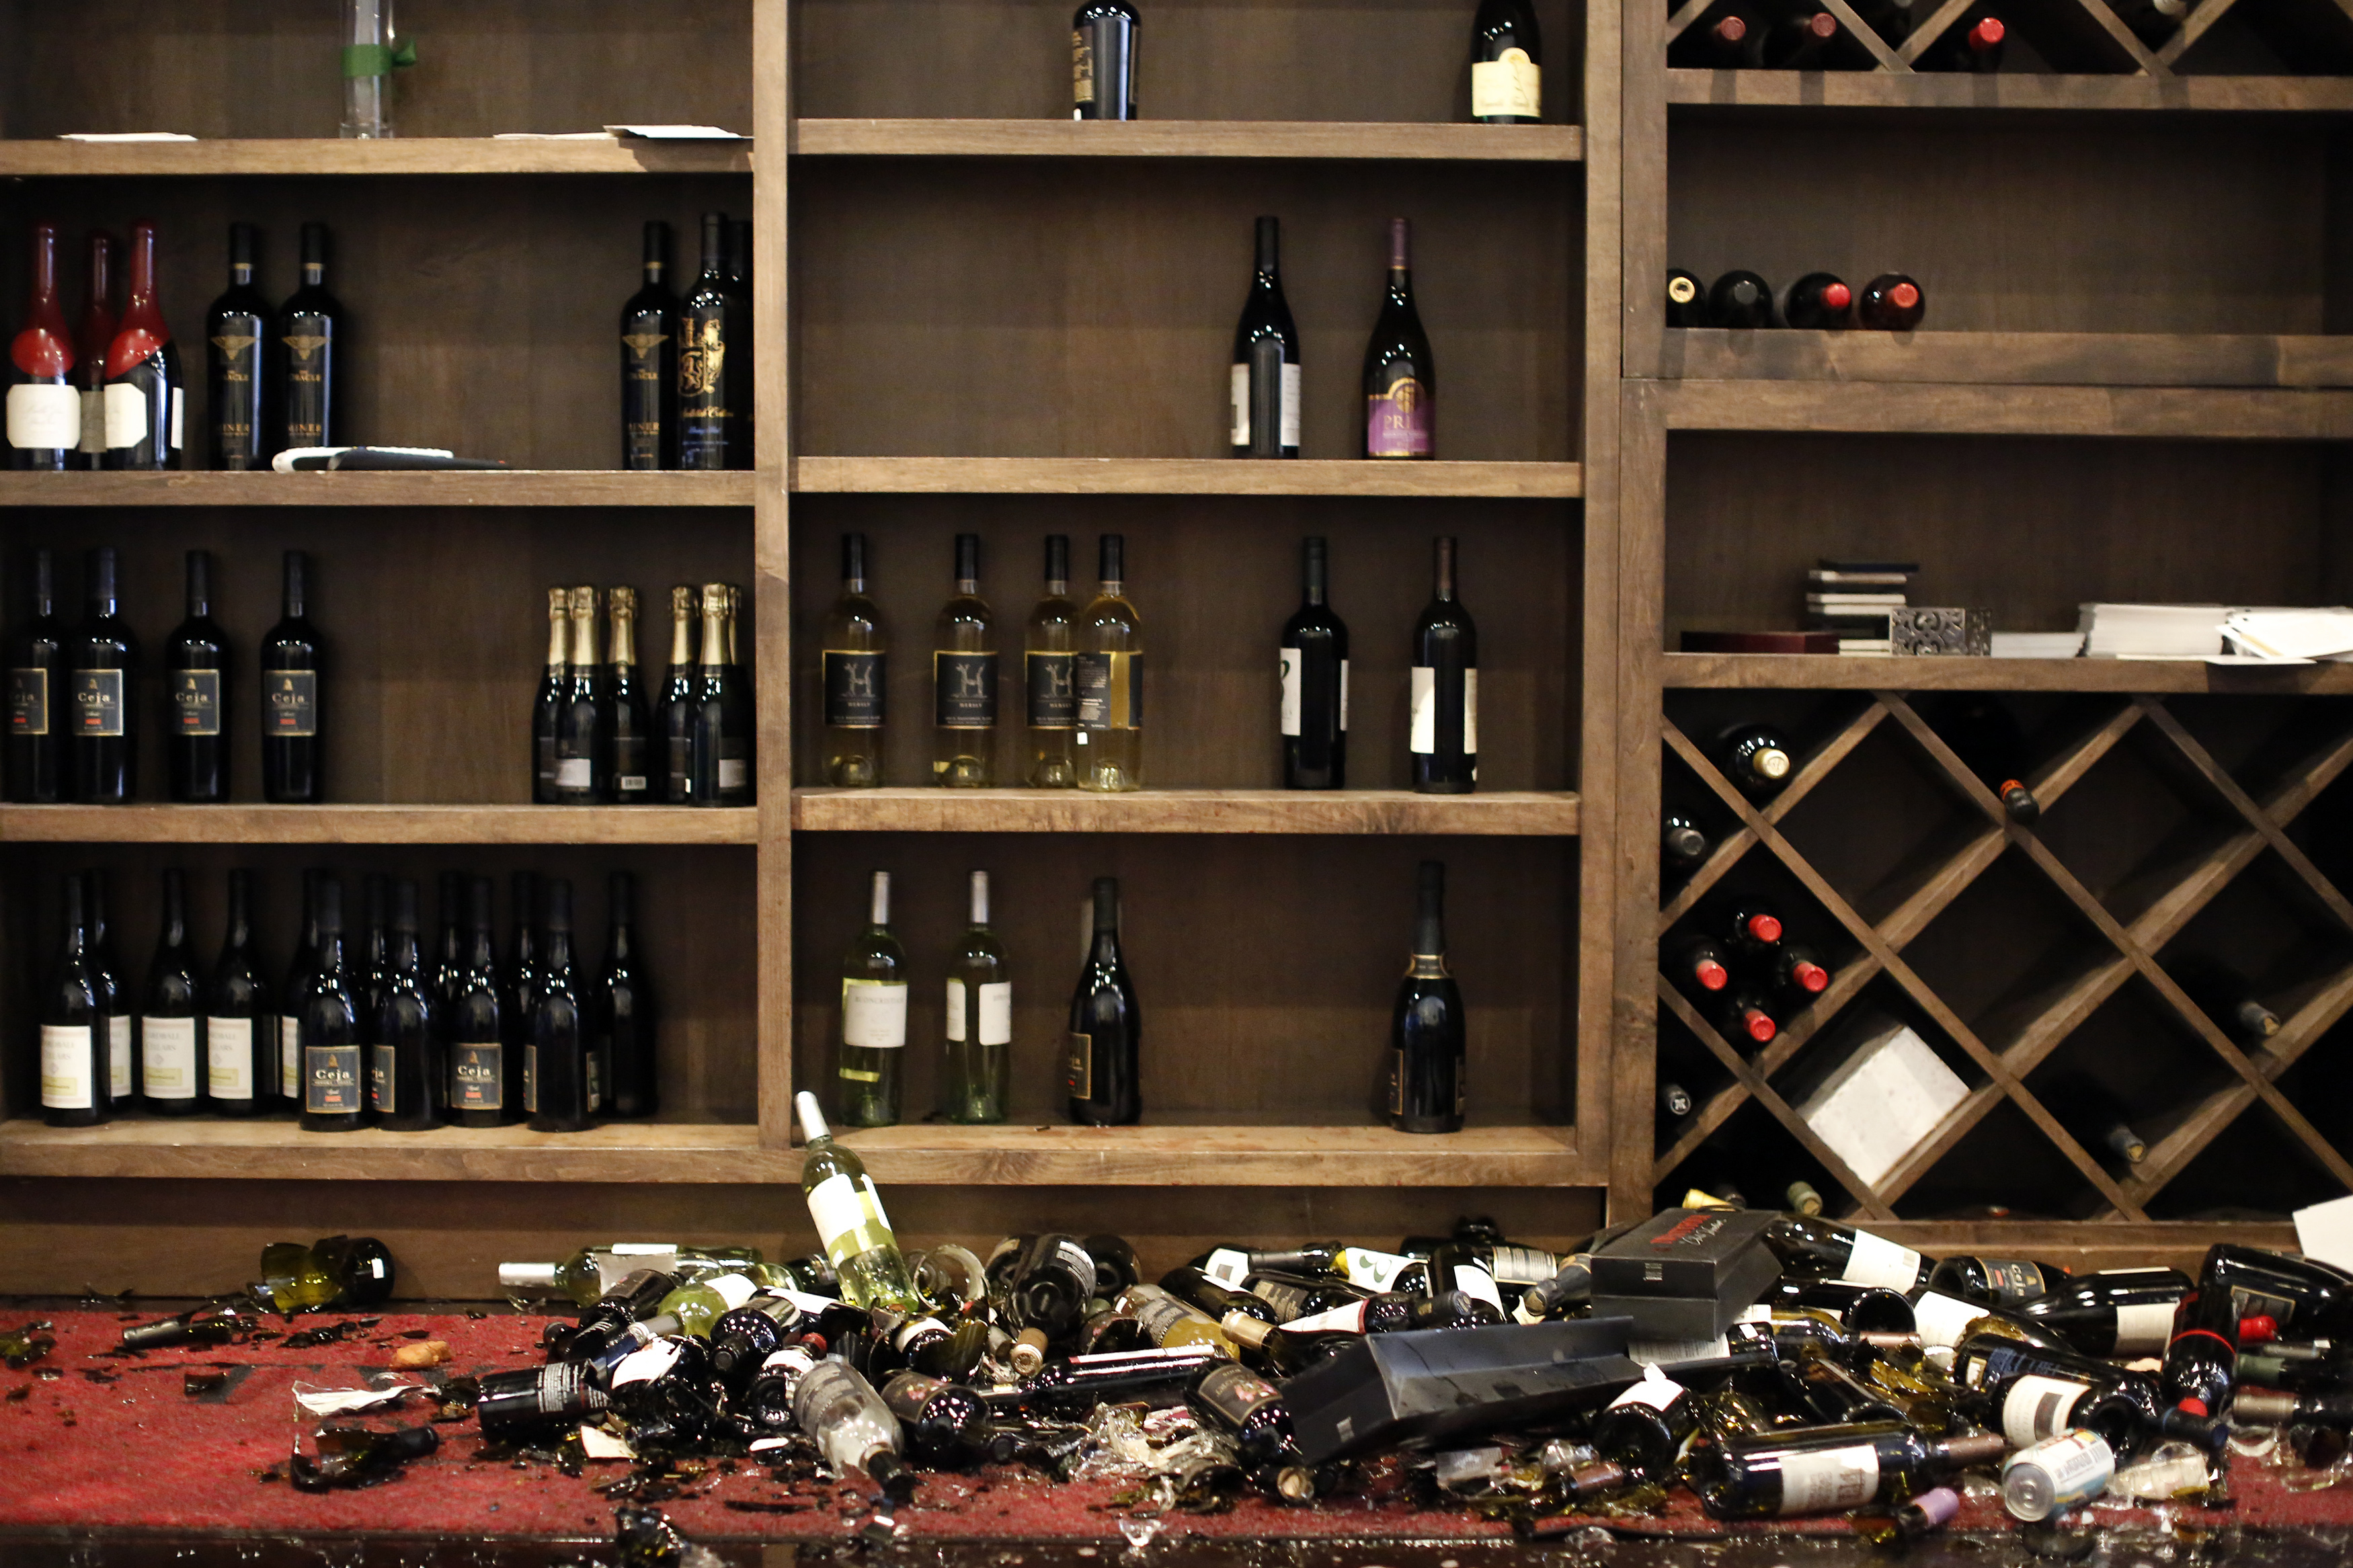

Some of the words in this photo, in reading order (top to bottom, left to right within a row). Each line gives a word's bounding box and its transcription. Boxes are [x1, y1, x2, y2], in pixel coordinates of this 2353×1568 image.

[77, 692, 111, 704] Ceja
[175, 692, 208, 704] Ceja
[272, 692, 306, 704] Ceja
[315, 1069, 350, 1081] Ceja
[458, 1065, 491, 1077] Ceja
[2011, 1263, 2026, 1296] Ceja
